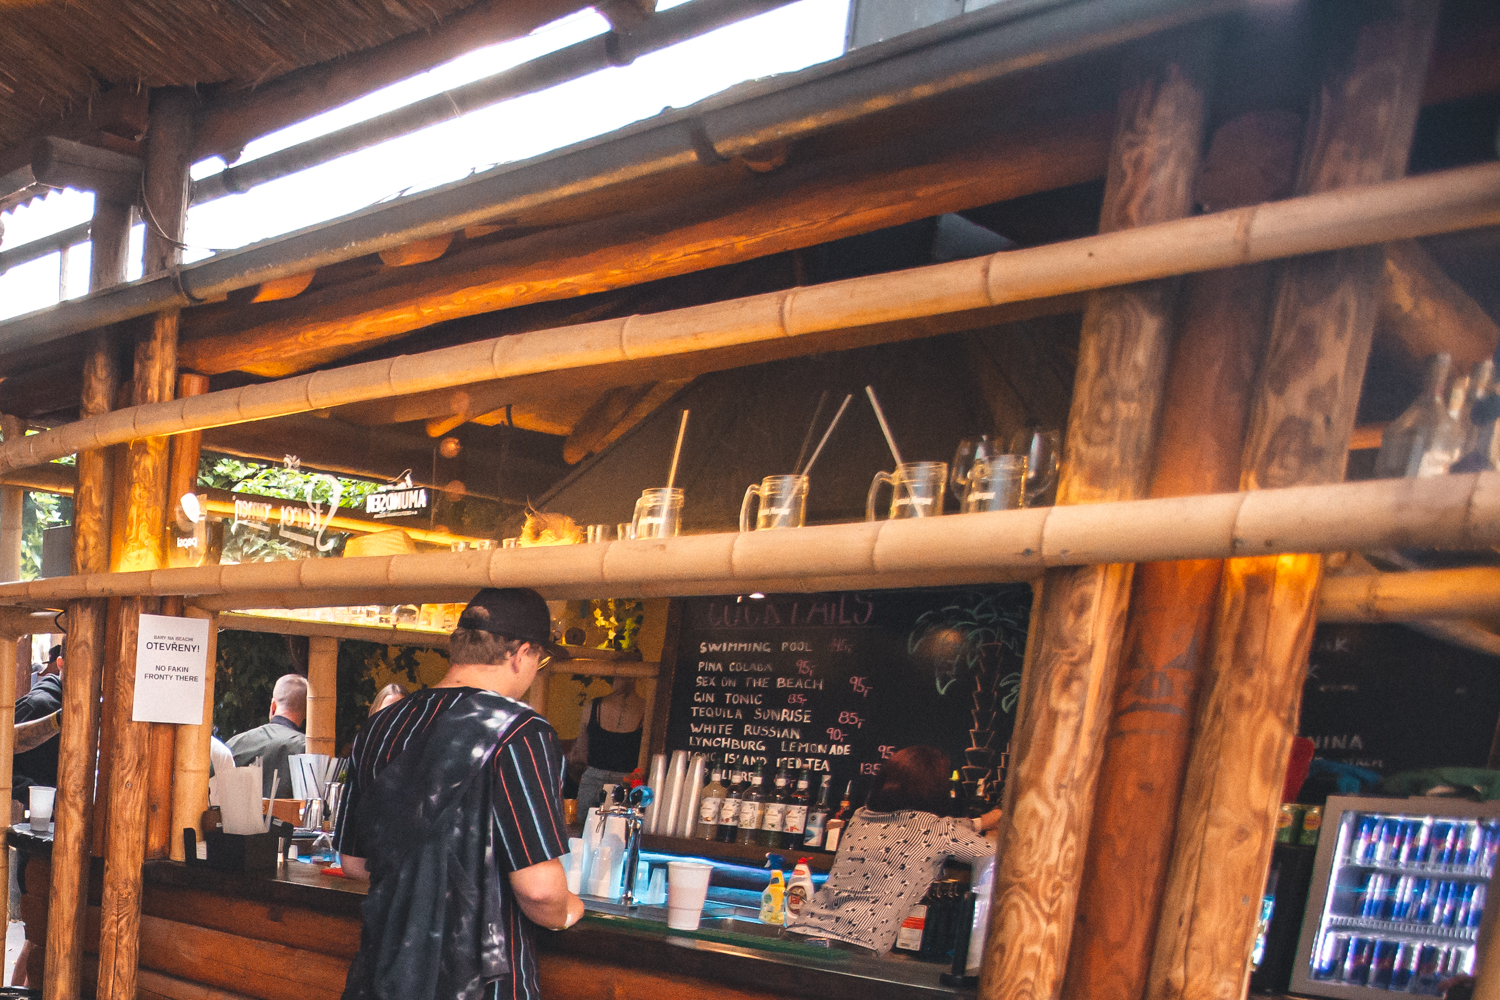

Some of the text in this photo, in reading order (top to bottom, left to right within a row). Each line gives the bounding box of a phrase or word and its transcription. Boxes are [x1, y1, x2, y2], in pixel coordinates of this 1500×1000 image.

[146, 641, 200, 653] OTEVŘENY!
[699, 641, 771, 653] SWIMMING
[781, 641, 813, 652] POOL
[167, 665, 189, 673] FAKIN
[698, 661, 723, 672] PINA
[729, 661, 773, 672] COLADA
[144, 673, 199, 682] FRONTY THERE
[695, 676, 716, 687] SEX
[721, 677, 737, 687] ON
[745, 677, 770, 688] THE
[776, 677, 824, 690] BEACH
[693, 692, 715, 703] GIN
[725, 693, 763, 705] TONIC
[690, 706, 743, 719] TEQUILA
[753, 708, 812, 723] SUNRISE
[690, 723, 734, 735] WHITE
[743, 724, 801, 740] RUSSIAN
[689, 736, 766, 751] LYNCHBURG
[805, 758, 831, 772] TEA
[721, 769, 754, 782] LIRE
